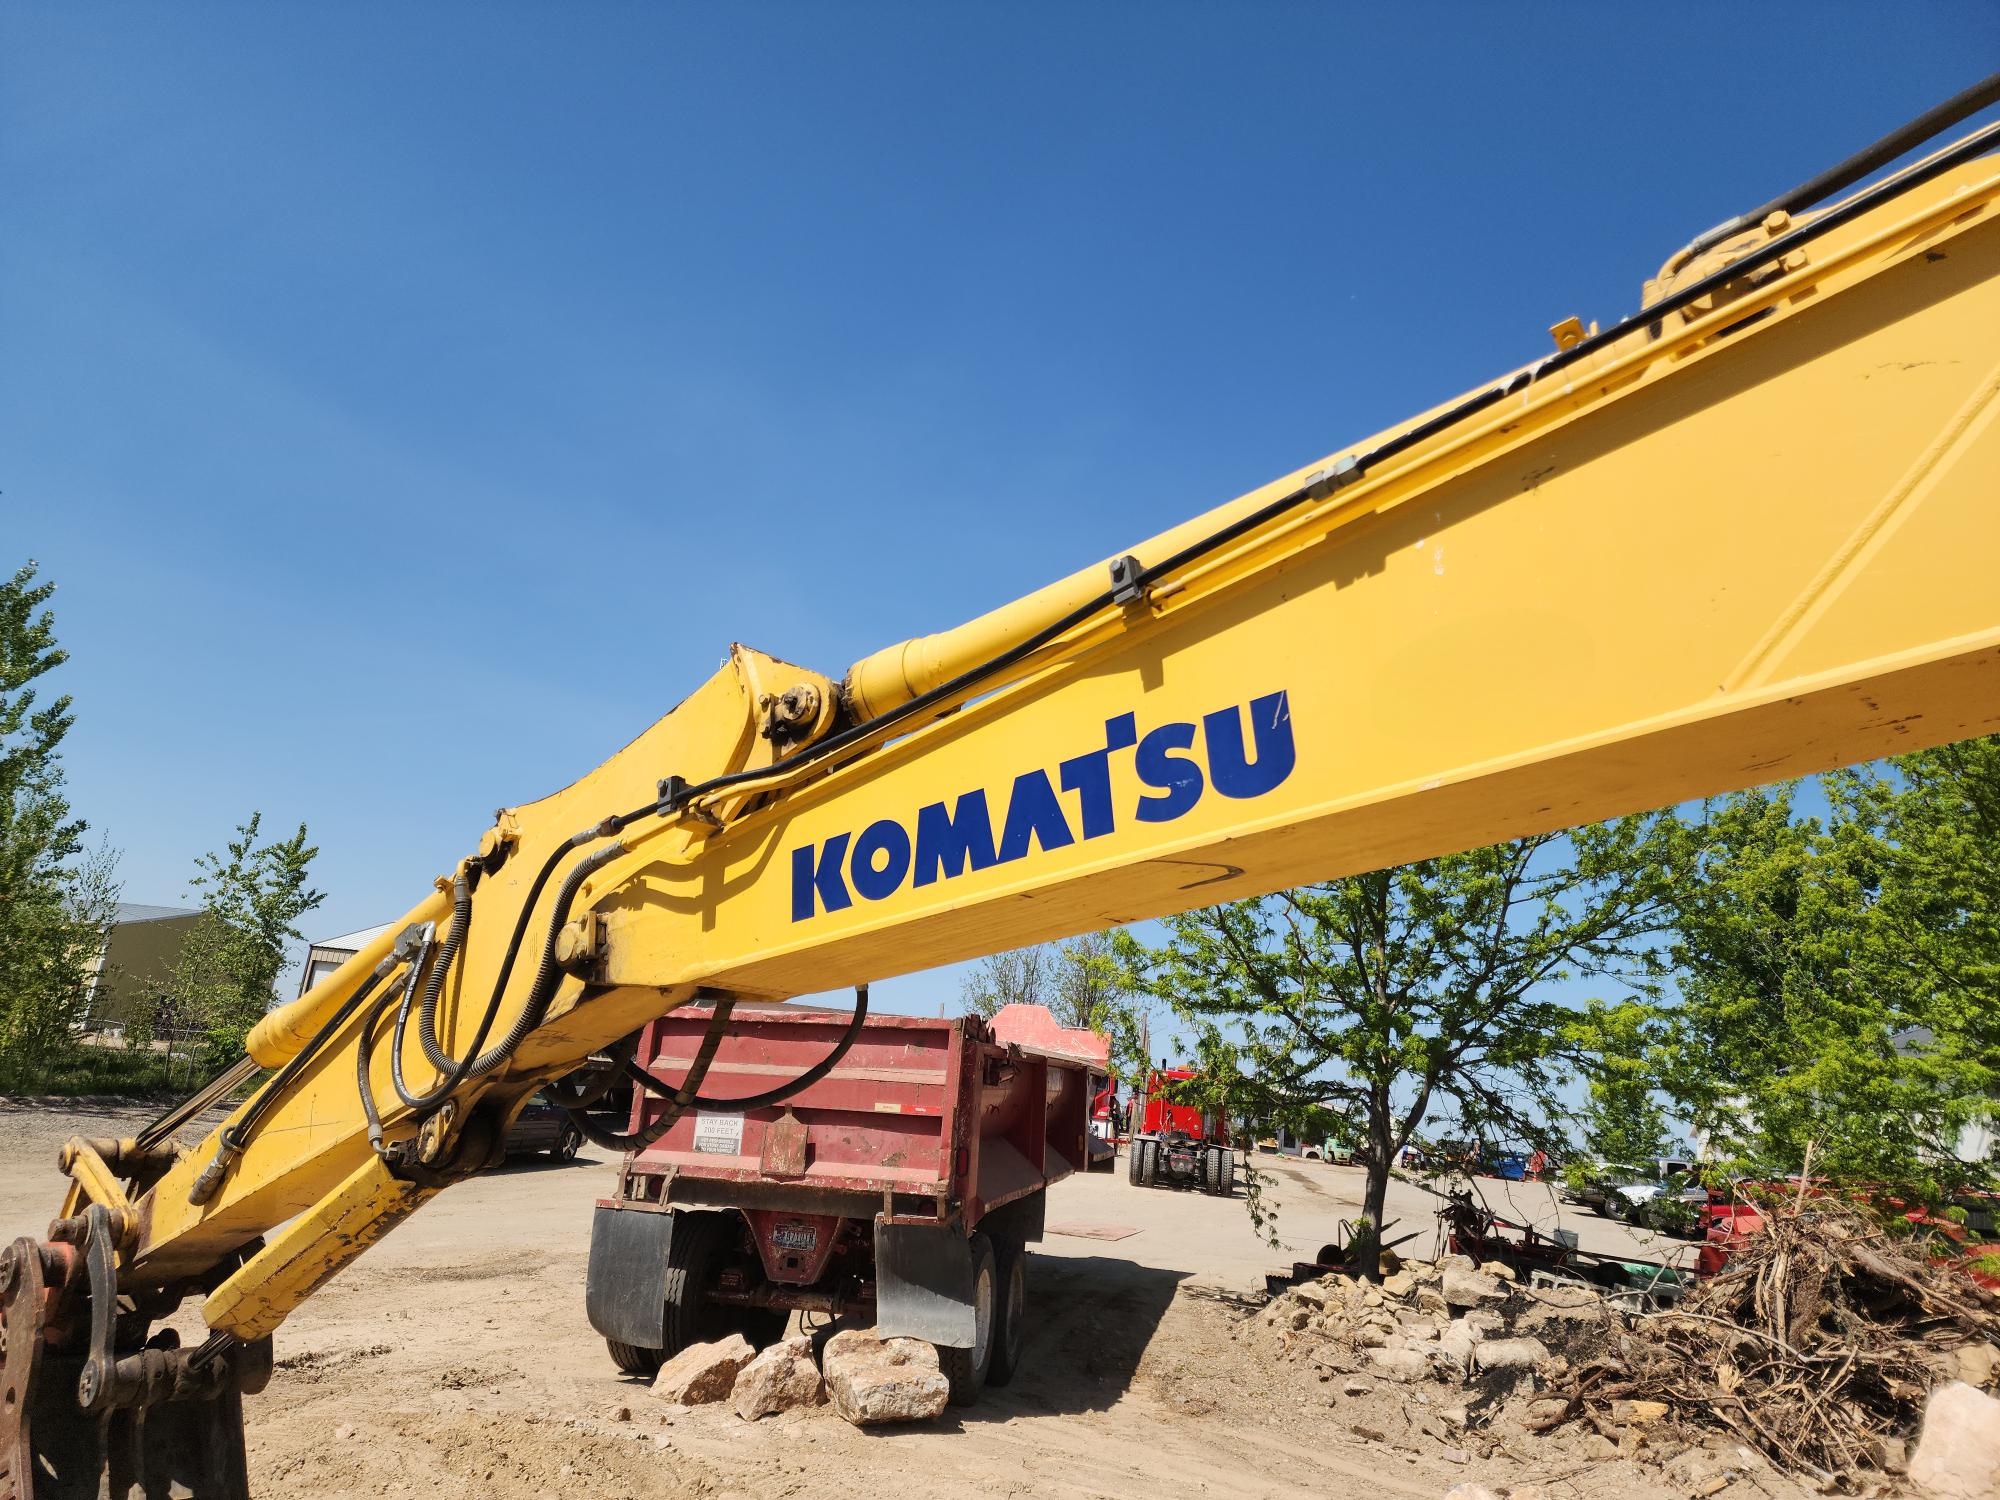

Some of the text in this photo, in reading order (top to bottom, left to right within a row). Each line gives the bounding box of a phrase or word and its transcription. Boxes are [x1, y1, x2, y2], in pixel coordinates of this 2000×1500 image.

[792, 689, 1296, 923] KOMATSU
[719, 1119, 738, 1127] BACK
[716, 1127, 735, 1135] FEET
